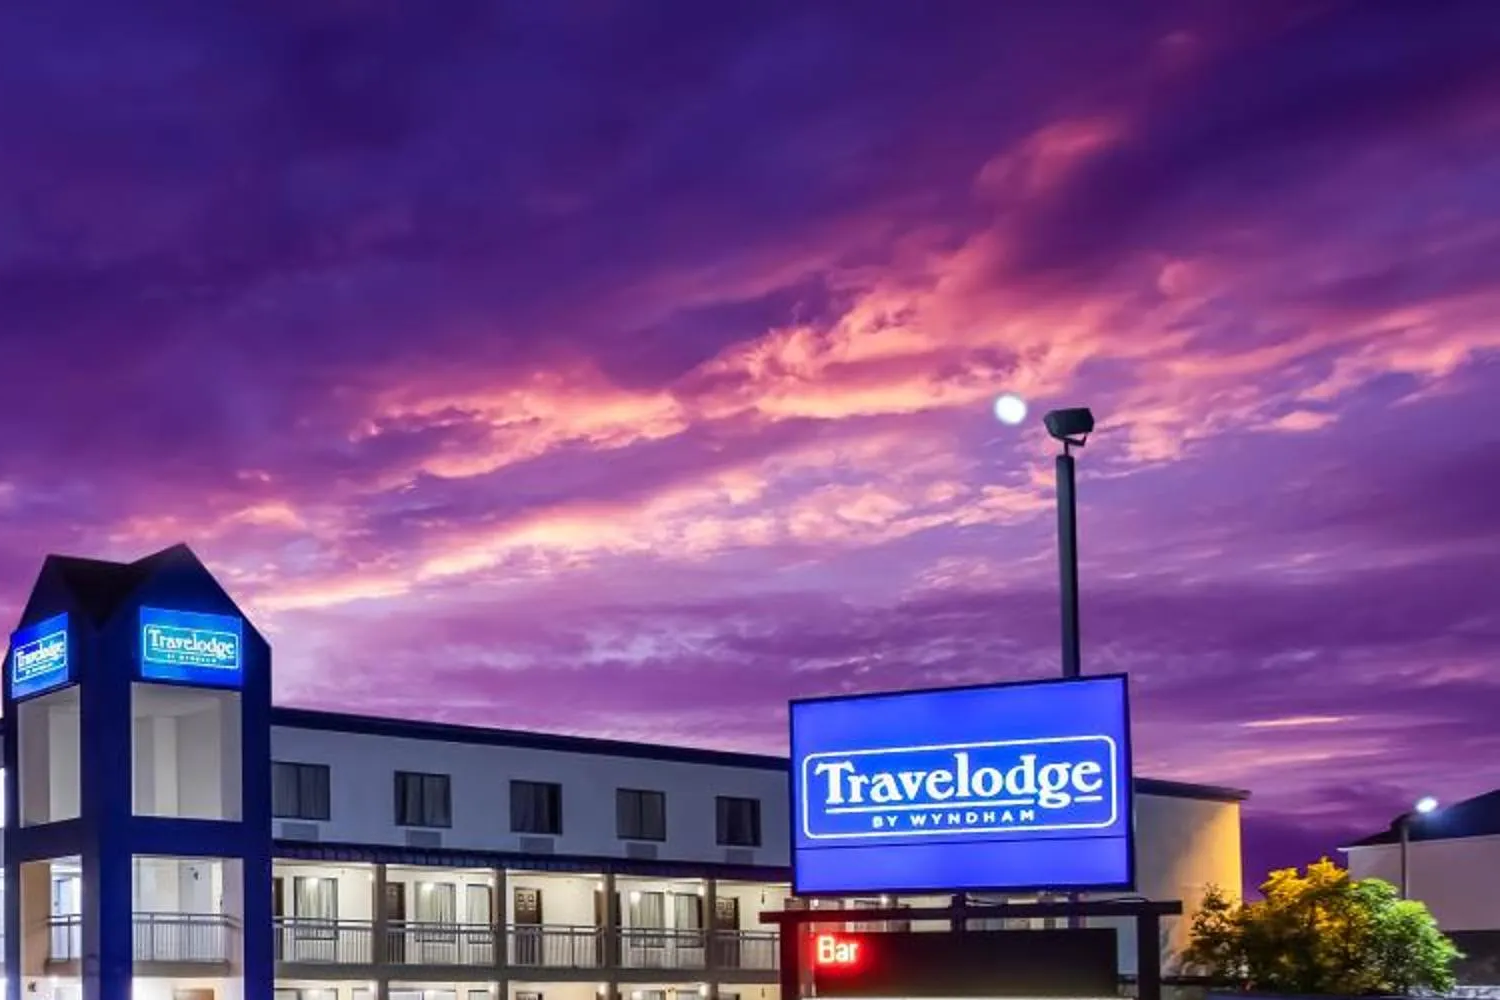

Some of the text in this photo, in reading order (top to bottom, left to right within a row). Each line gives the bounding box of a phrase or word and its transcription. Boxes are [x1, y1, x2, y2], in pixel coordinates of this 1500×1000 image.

[148, 629, 235, 660] Travelodge
[814, 752, 1103, 808] Travelodge
[872, 809, 1035, 829] BY WYNDHAM
[817, 934, 859, 964] Bar
